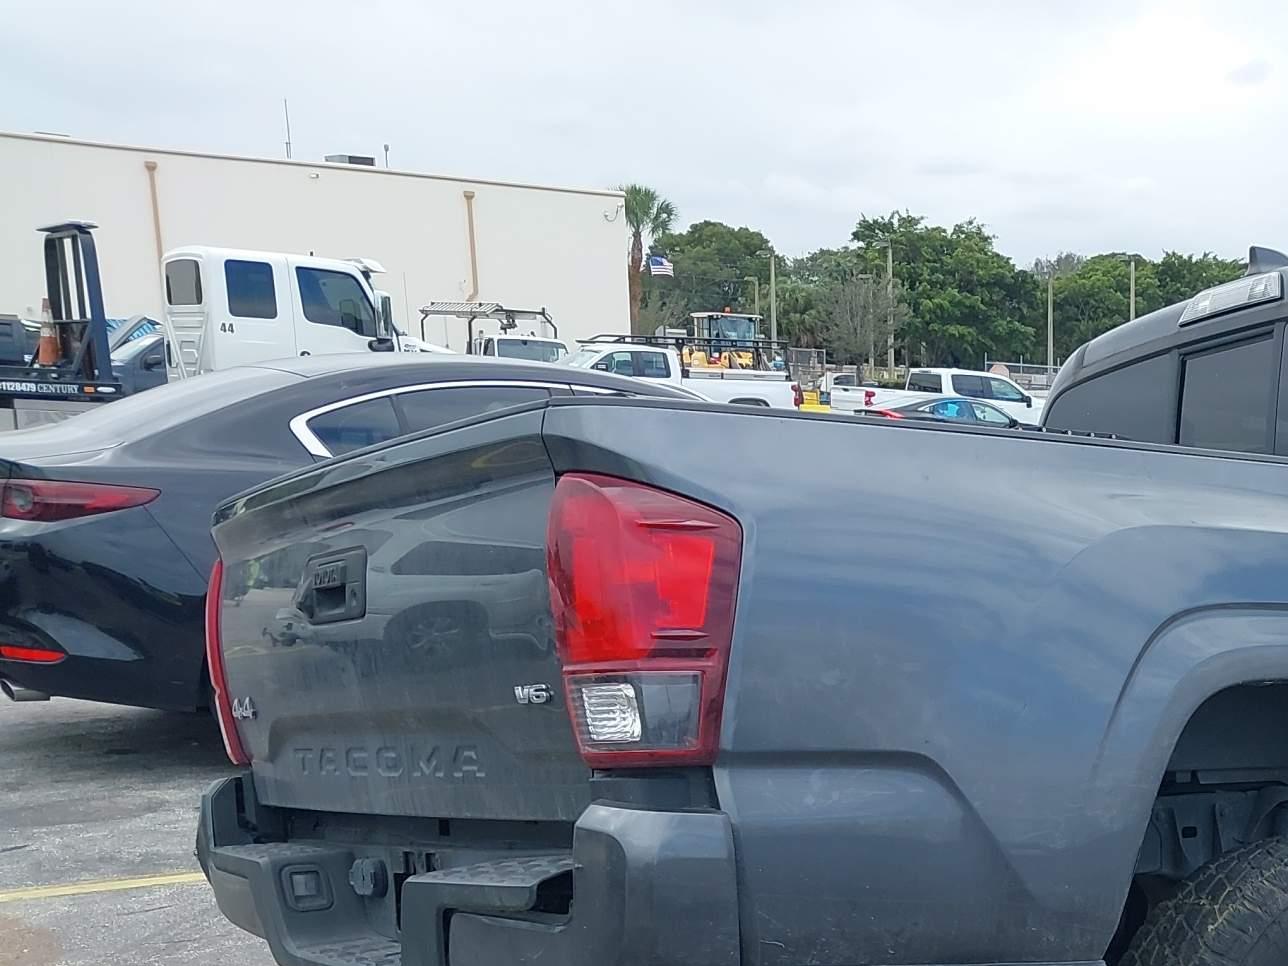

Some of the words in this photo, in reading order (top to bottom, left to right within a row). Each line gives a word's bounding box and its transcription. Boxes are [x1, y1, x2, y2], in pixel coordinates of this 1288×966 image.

[220, 322, 235, 333] 44
[0, 381, 36, 393] 1128479
[37, 384, 79, 393] CENTURY
[513, 684, 550, 704] V6
[294, 746, 486, 777] TACOMA
